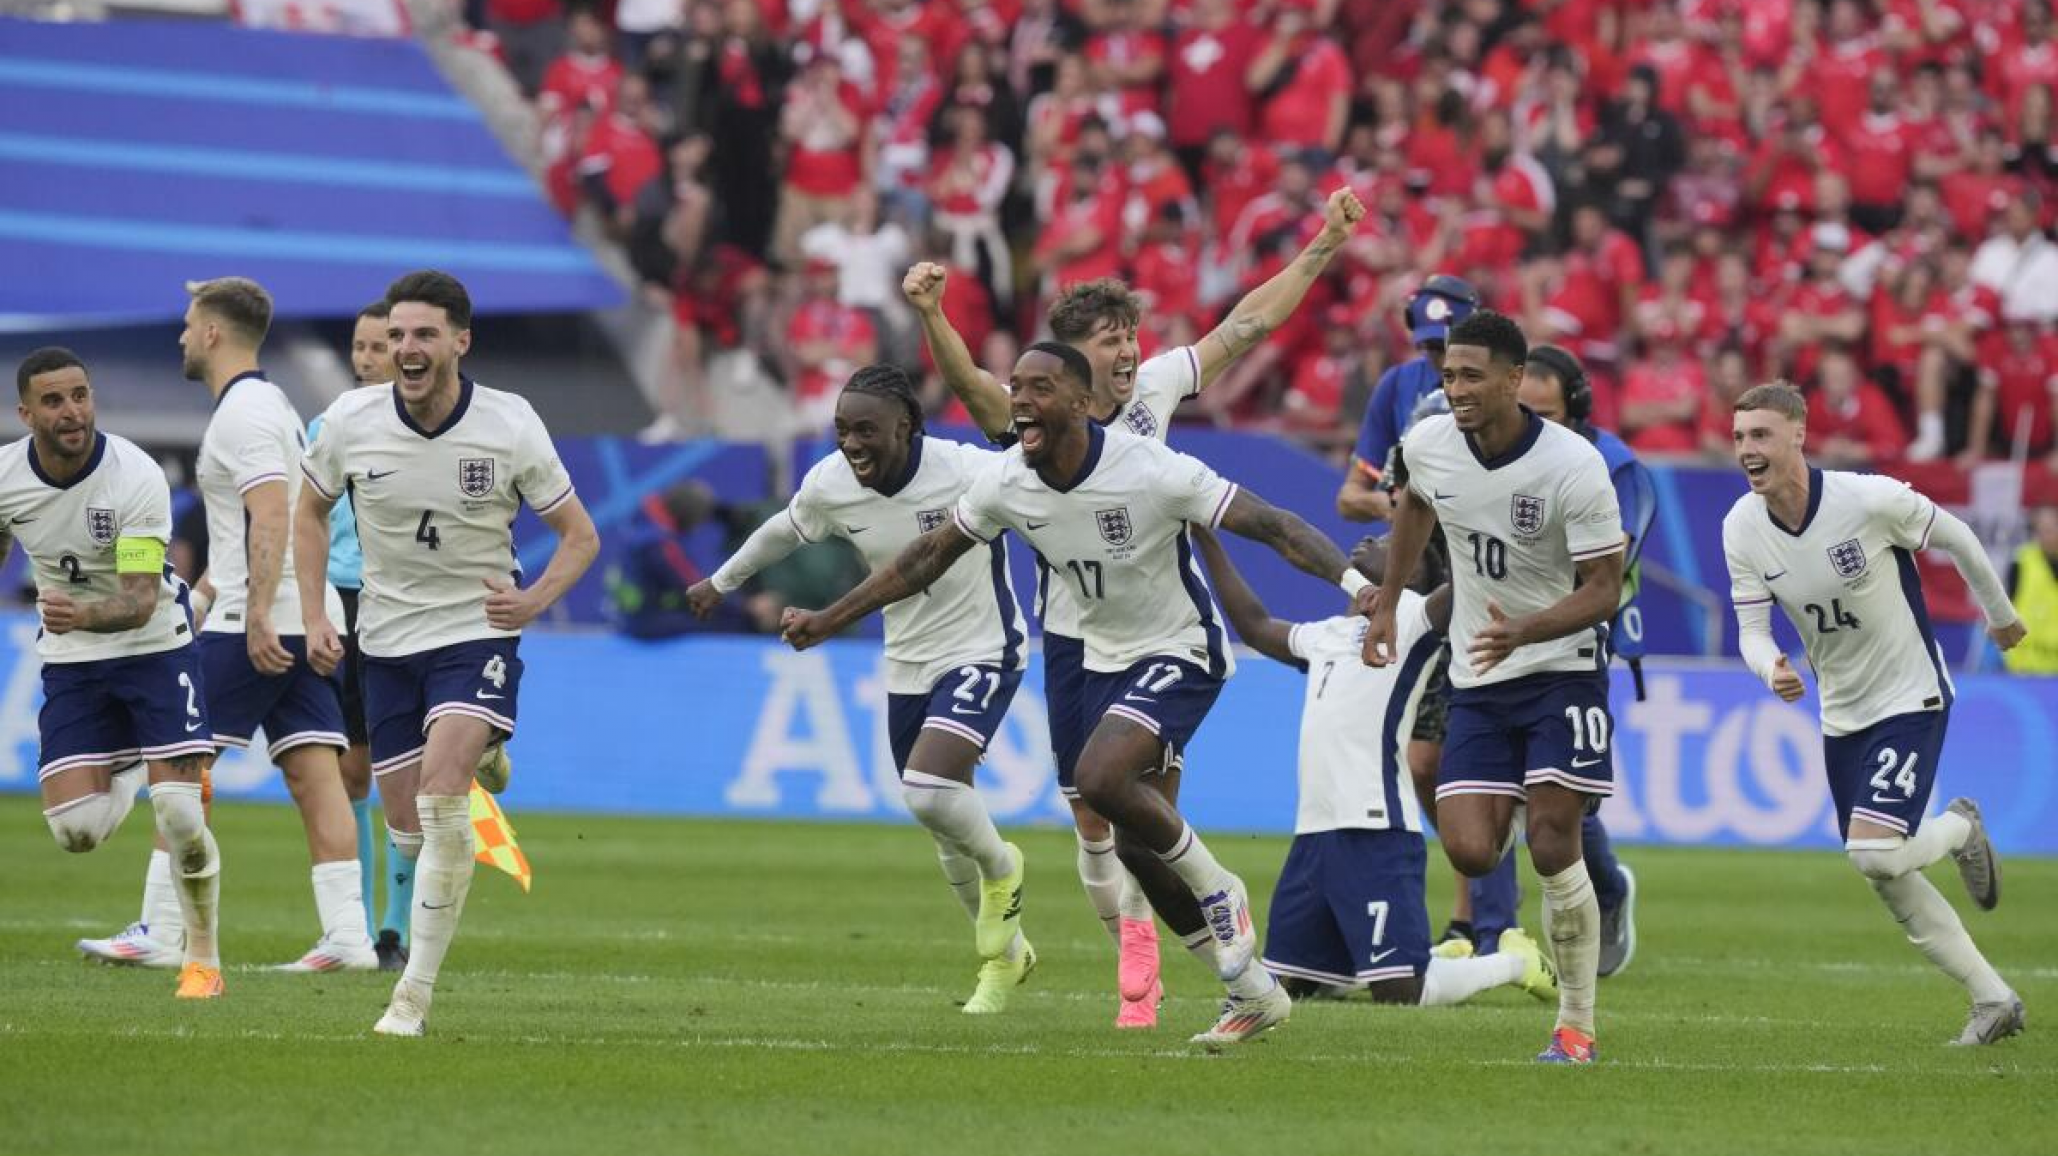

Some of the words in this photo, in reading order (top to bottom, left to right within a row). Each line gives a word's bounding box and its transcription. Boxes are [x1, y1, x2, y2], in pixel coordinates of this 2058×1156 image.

[416, 509, 441, 550] 4
[59, 553, 91, 583] 2
[1468, 533, 1507, 581] 10
[1066, 560, 1104, 599] 17
[1803, 599, 1861, 633] 24
[481, 654, 506, 688] 4
[953, 666, 1001, 709] 21
[1136, 663, 1183, 693] 17
[1316, 661, 1335, 699] 7
[177, 671, 200, 717] 2
[1565, 706, 1608, 753] 10
[1870, 747, 1918, 798] 24
[1367, 901, 1389, 946] 7
